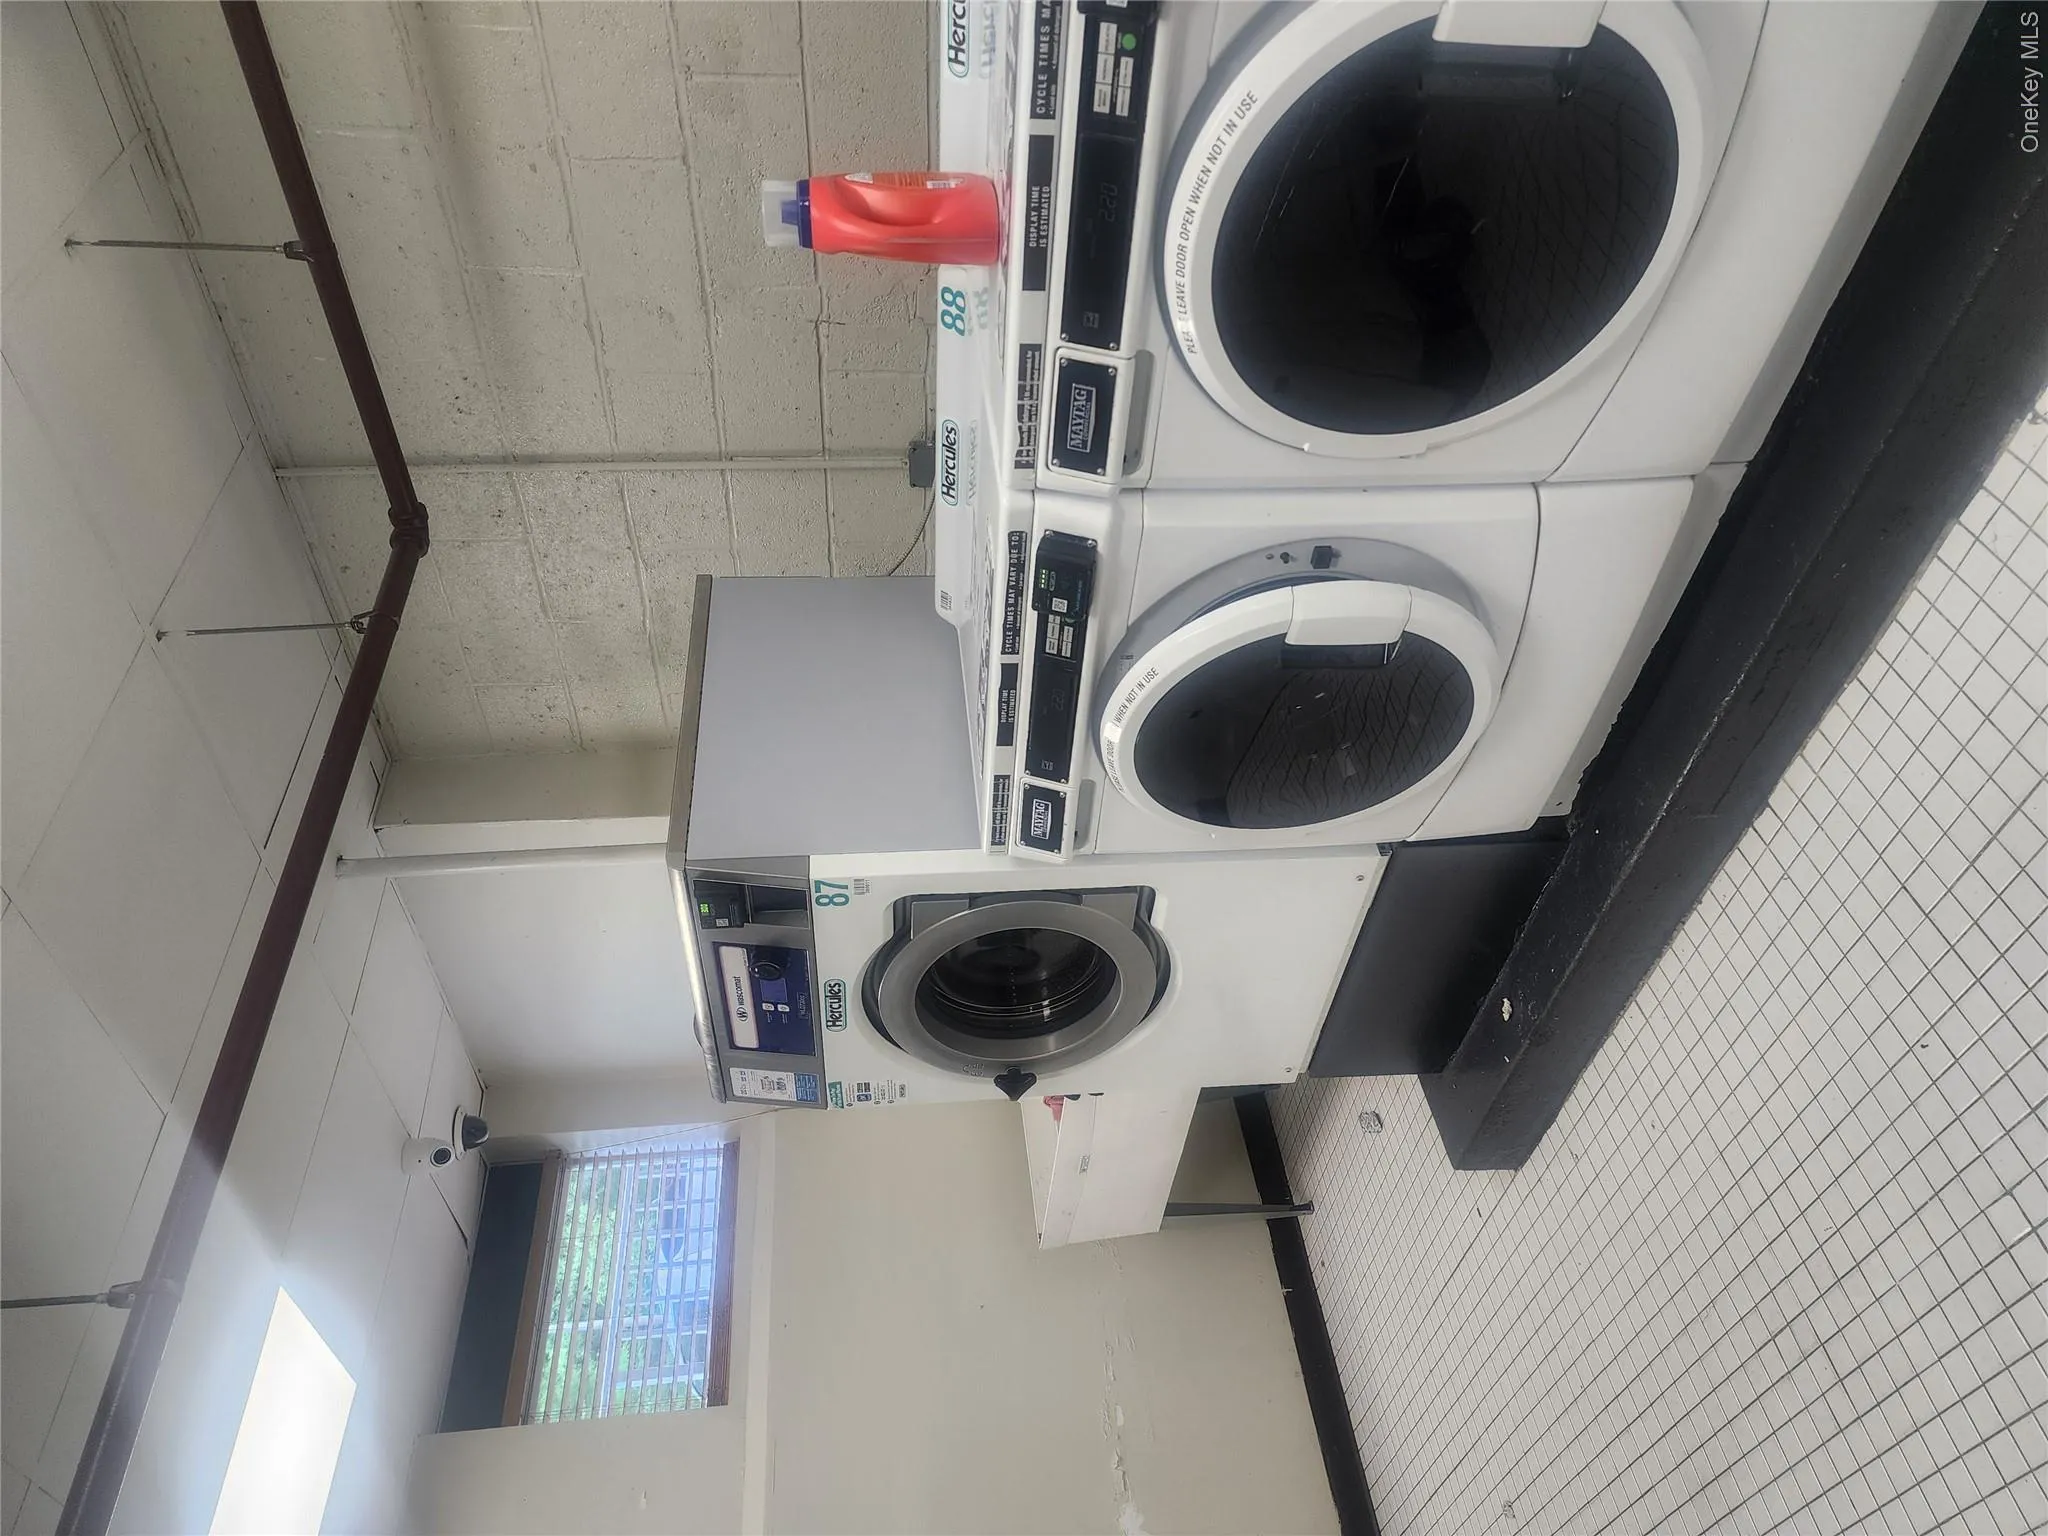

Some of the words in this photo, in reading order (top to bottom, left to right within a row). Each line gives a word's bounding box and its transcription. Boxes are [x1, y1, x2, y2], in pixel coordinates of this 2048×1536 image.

[948, 0, 966, 67] Herc
[1038, 25, 1050, 66] TIMES
[1036, 74, 1048, 114] CYCLE
[1234, 90, 1258, 120] USE
[1223, 119, 1238, 136] IN
[1206, 135, 1226, 165] NOT
[1031, 186, 1041, 208] TIME
[1188, 165, 1212, 204] WHEN
[1040, 186, 1050, 235] ESTIMATED
[1179, 207, 1196, 241] OPEN
[1029, 211, 1039, 247] DISPLAY
[1040, 237, 1049, 247] IS
[1175, 244, 1187, 278] DOOR
[940, 286, 966, 336] 88
[1175, 280, 1188, 314] LEAVE
[1070, 389, 1087, 448] MAYTAG
[941, 426, 957, 500] Hercules
[1012, 532, 1020, 546] TO:
[1010, 549, 1019, 564] DUE
[1008, 567, 1017, 586] VARY
[1008, 588, 1016, 604] MAY
[1006, 606, 1014, 628] TIMES
[1004, 631, 1013, 652] CYCLE
[1113, 704, 1129, 723] WHEN
[1122, 688, 1138, 704] NOT
[1135, 681, 1145, 691] IN
[1142, 667, 1159, 683] USE
[1000, 703, 1008, 722] DISPLAY
[1034, 802, 1045, 836] MAYTAG
[814, 880, 850, 907] 87
[733, 976, 744, 1006] wascomat
[826, 982, 842, 1028] Hercules
